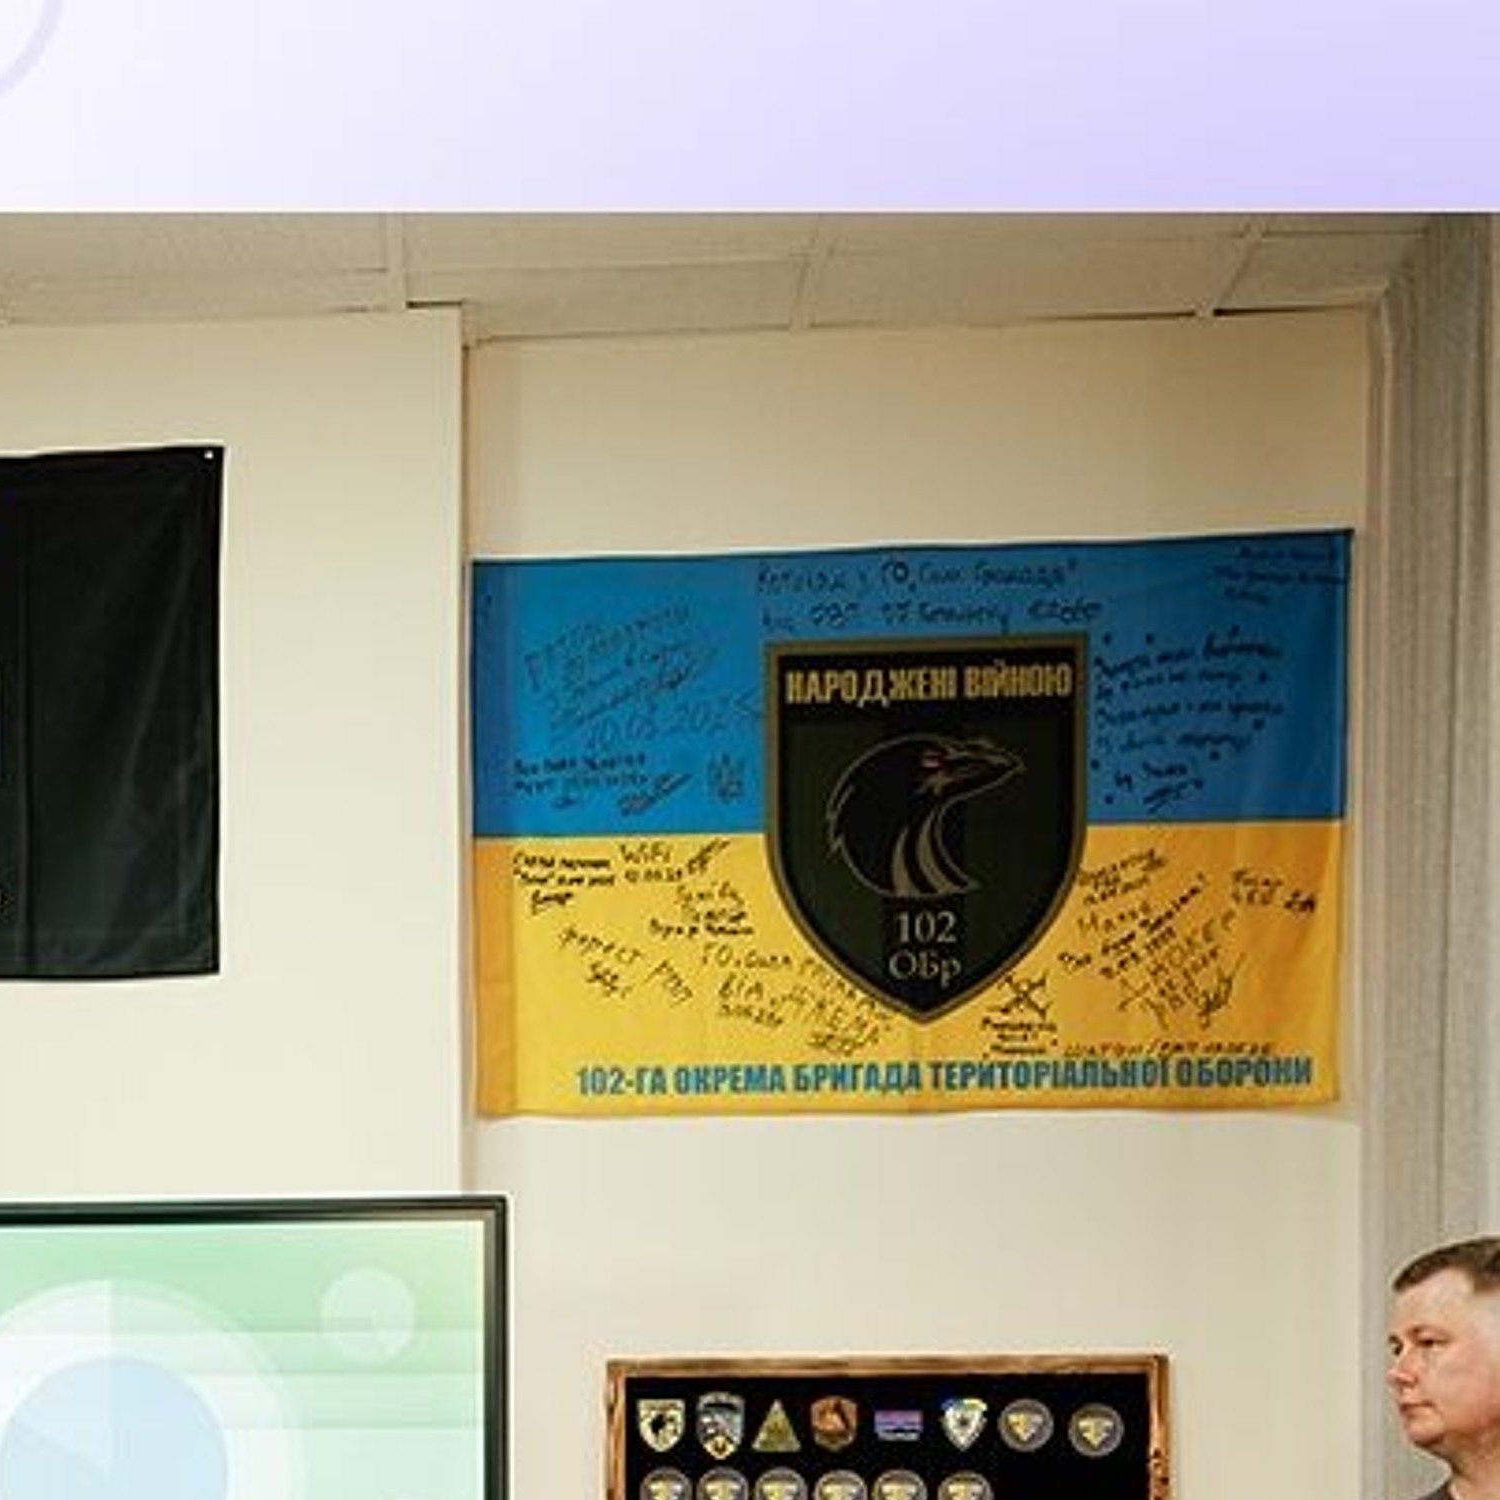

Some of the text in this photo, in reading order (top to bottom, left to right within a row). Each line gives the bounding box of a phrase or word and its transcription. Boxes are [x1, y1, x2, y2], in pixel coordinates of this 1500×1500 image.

[786, 659, 1072, 708] НАРОДЖЕНІ ВІЙНОЮ
[898, 910, 958, 944] 102
[888, 948, 962, 987] ОБр
[578, 1055, 1313, 1096] 102-ГА ОКРЕМА БРИГАДА ТЕРИТОРІАЛЬНОЇ ОБОРОНИ
